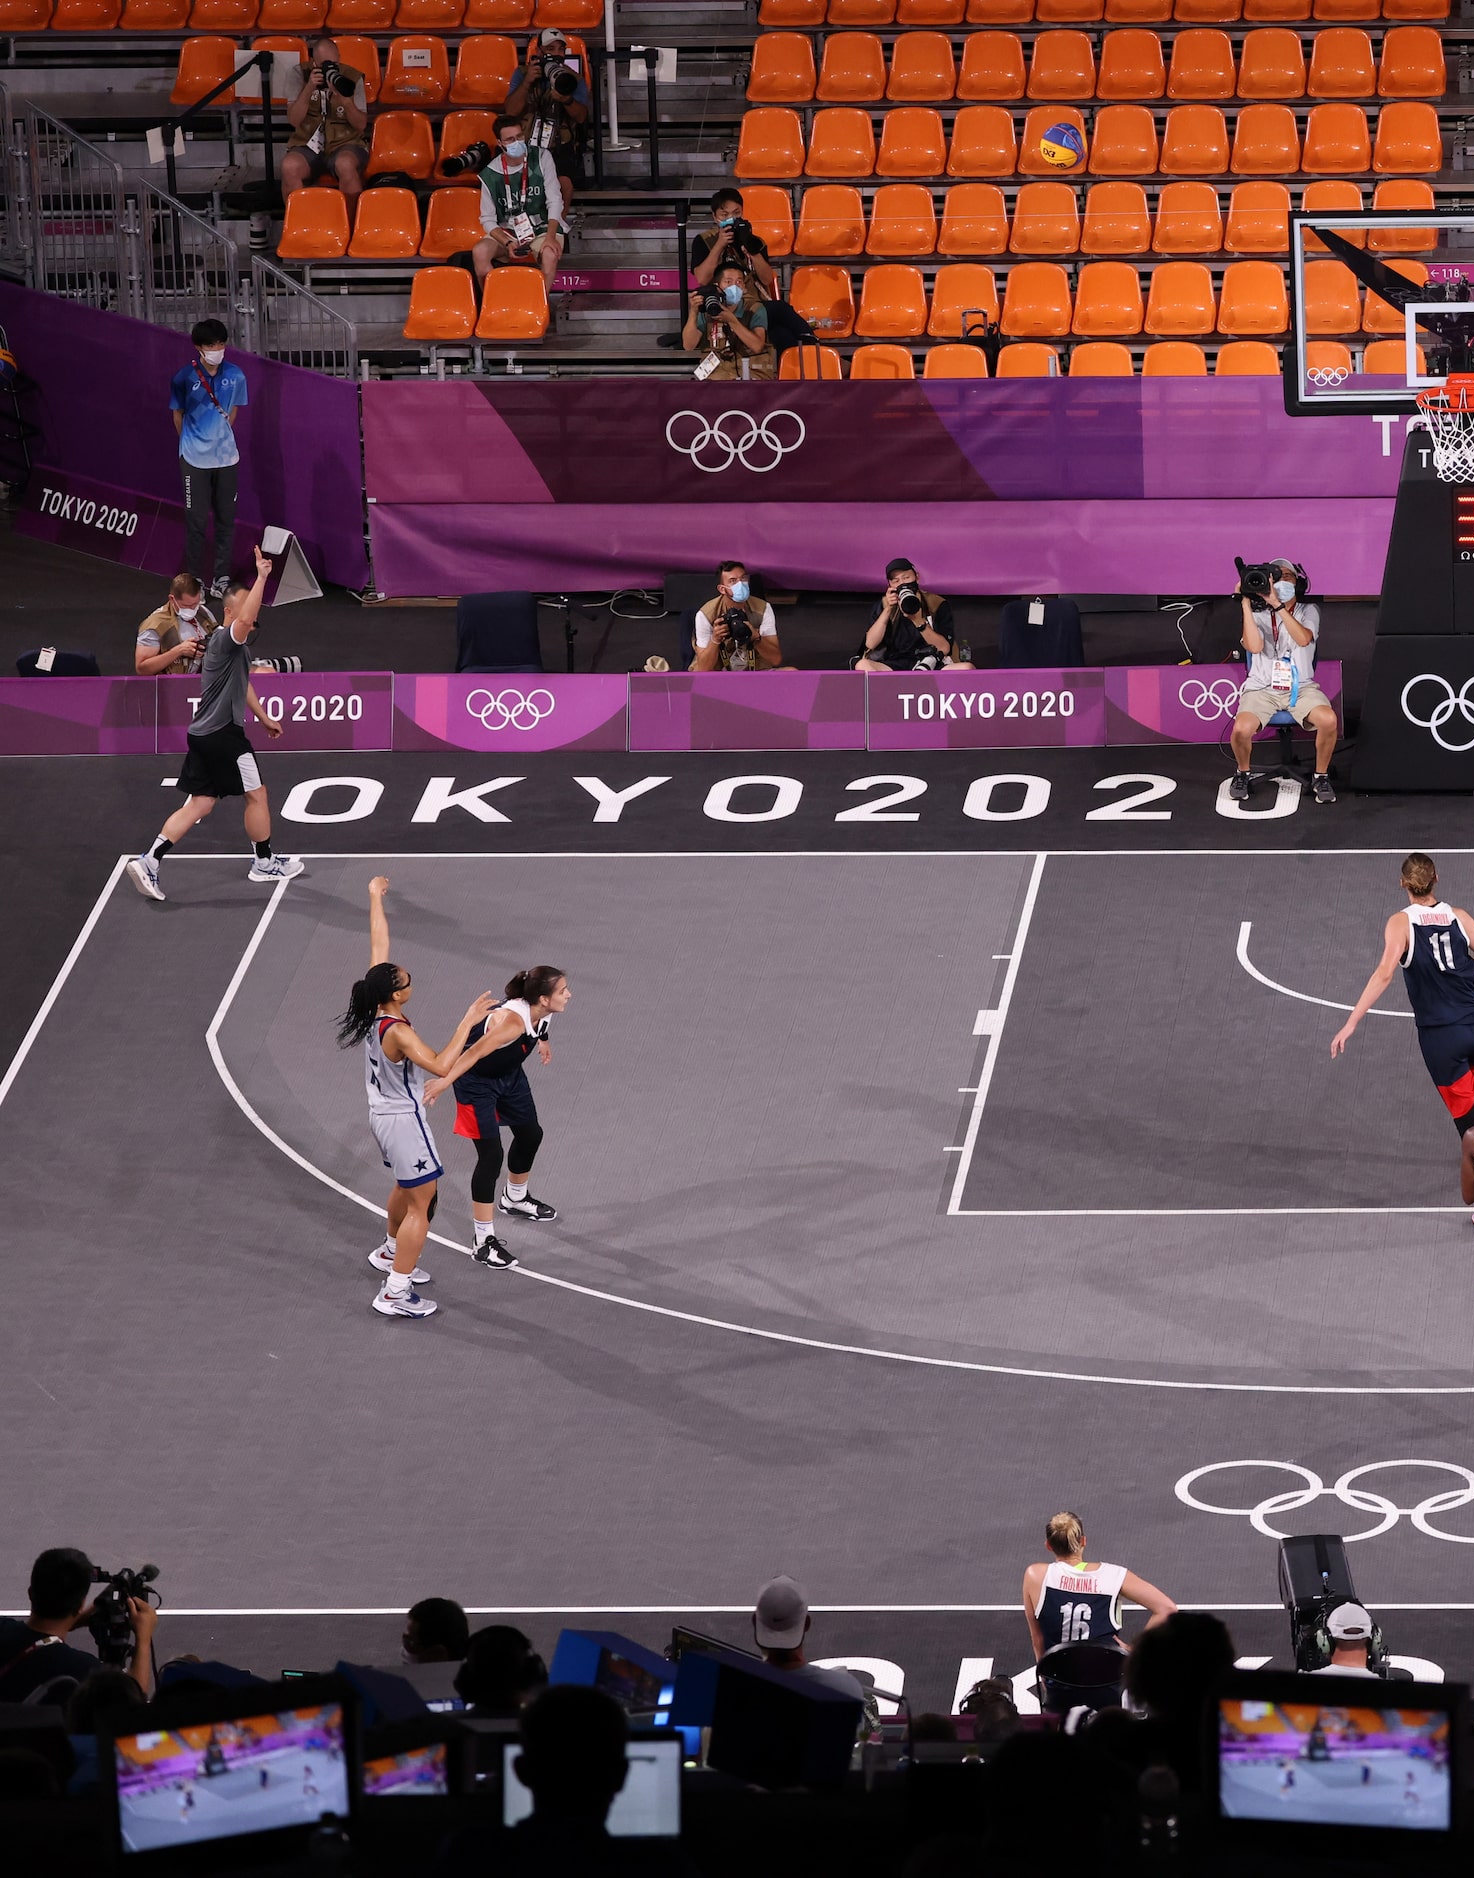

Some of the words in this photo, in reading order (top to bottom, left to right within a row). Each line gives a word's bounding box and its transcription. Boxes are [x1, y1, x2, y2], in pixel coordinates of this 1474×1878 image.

[562, 276, 580, 286] 117
[640, 274, 648, 286] C
[1442, 268, 1460, 278] 118
[40, 488, 96, 525] TOKYO
[95, 505, 138, 537] 2020
[292, 694, 363, 722] 2020
[897, 692, 995, 721] TOKYO
[1003, 691, 1075, 718] 2020
[1428, 931, 1456, 972] 11
[1059, 1575, 1093, 1593] FROLKINA
[1060, 1601, 1092, 1643] 16
